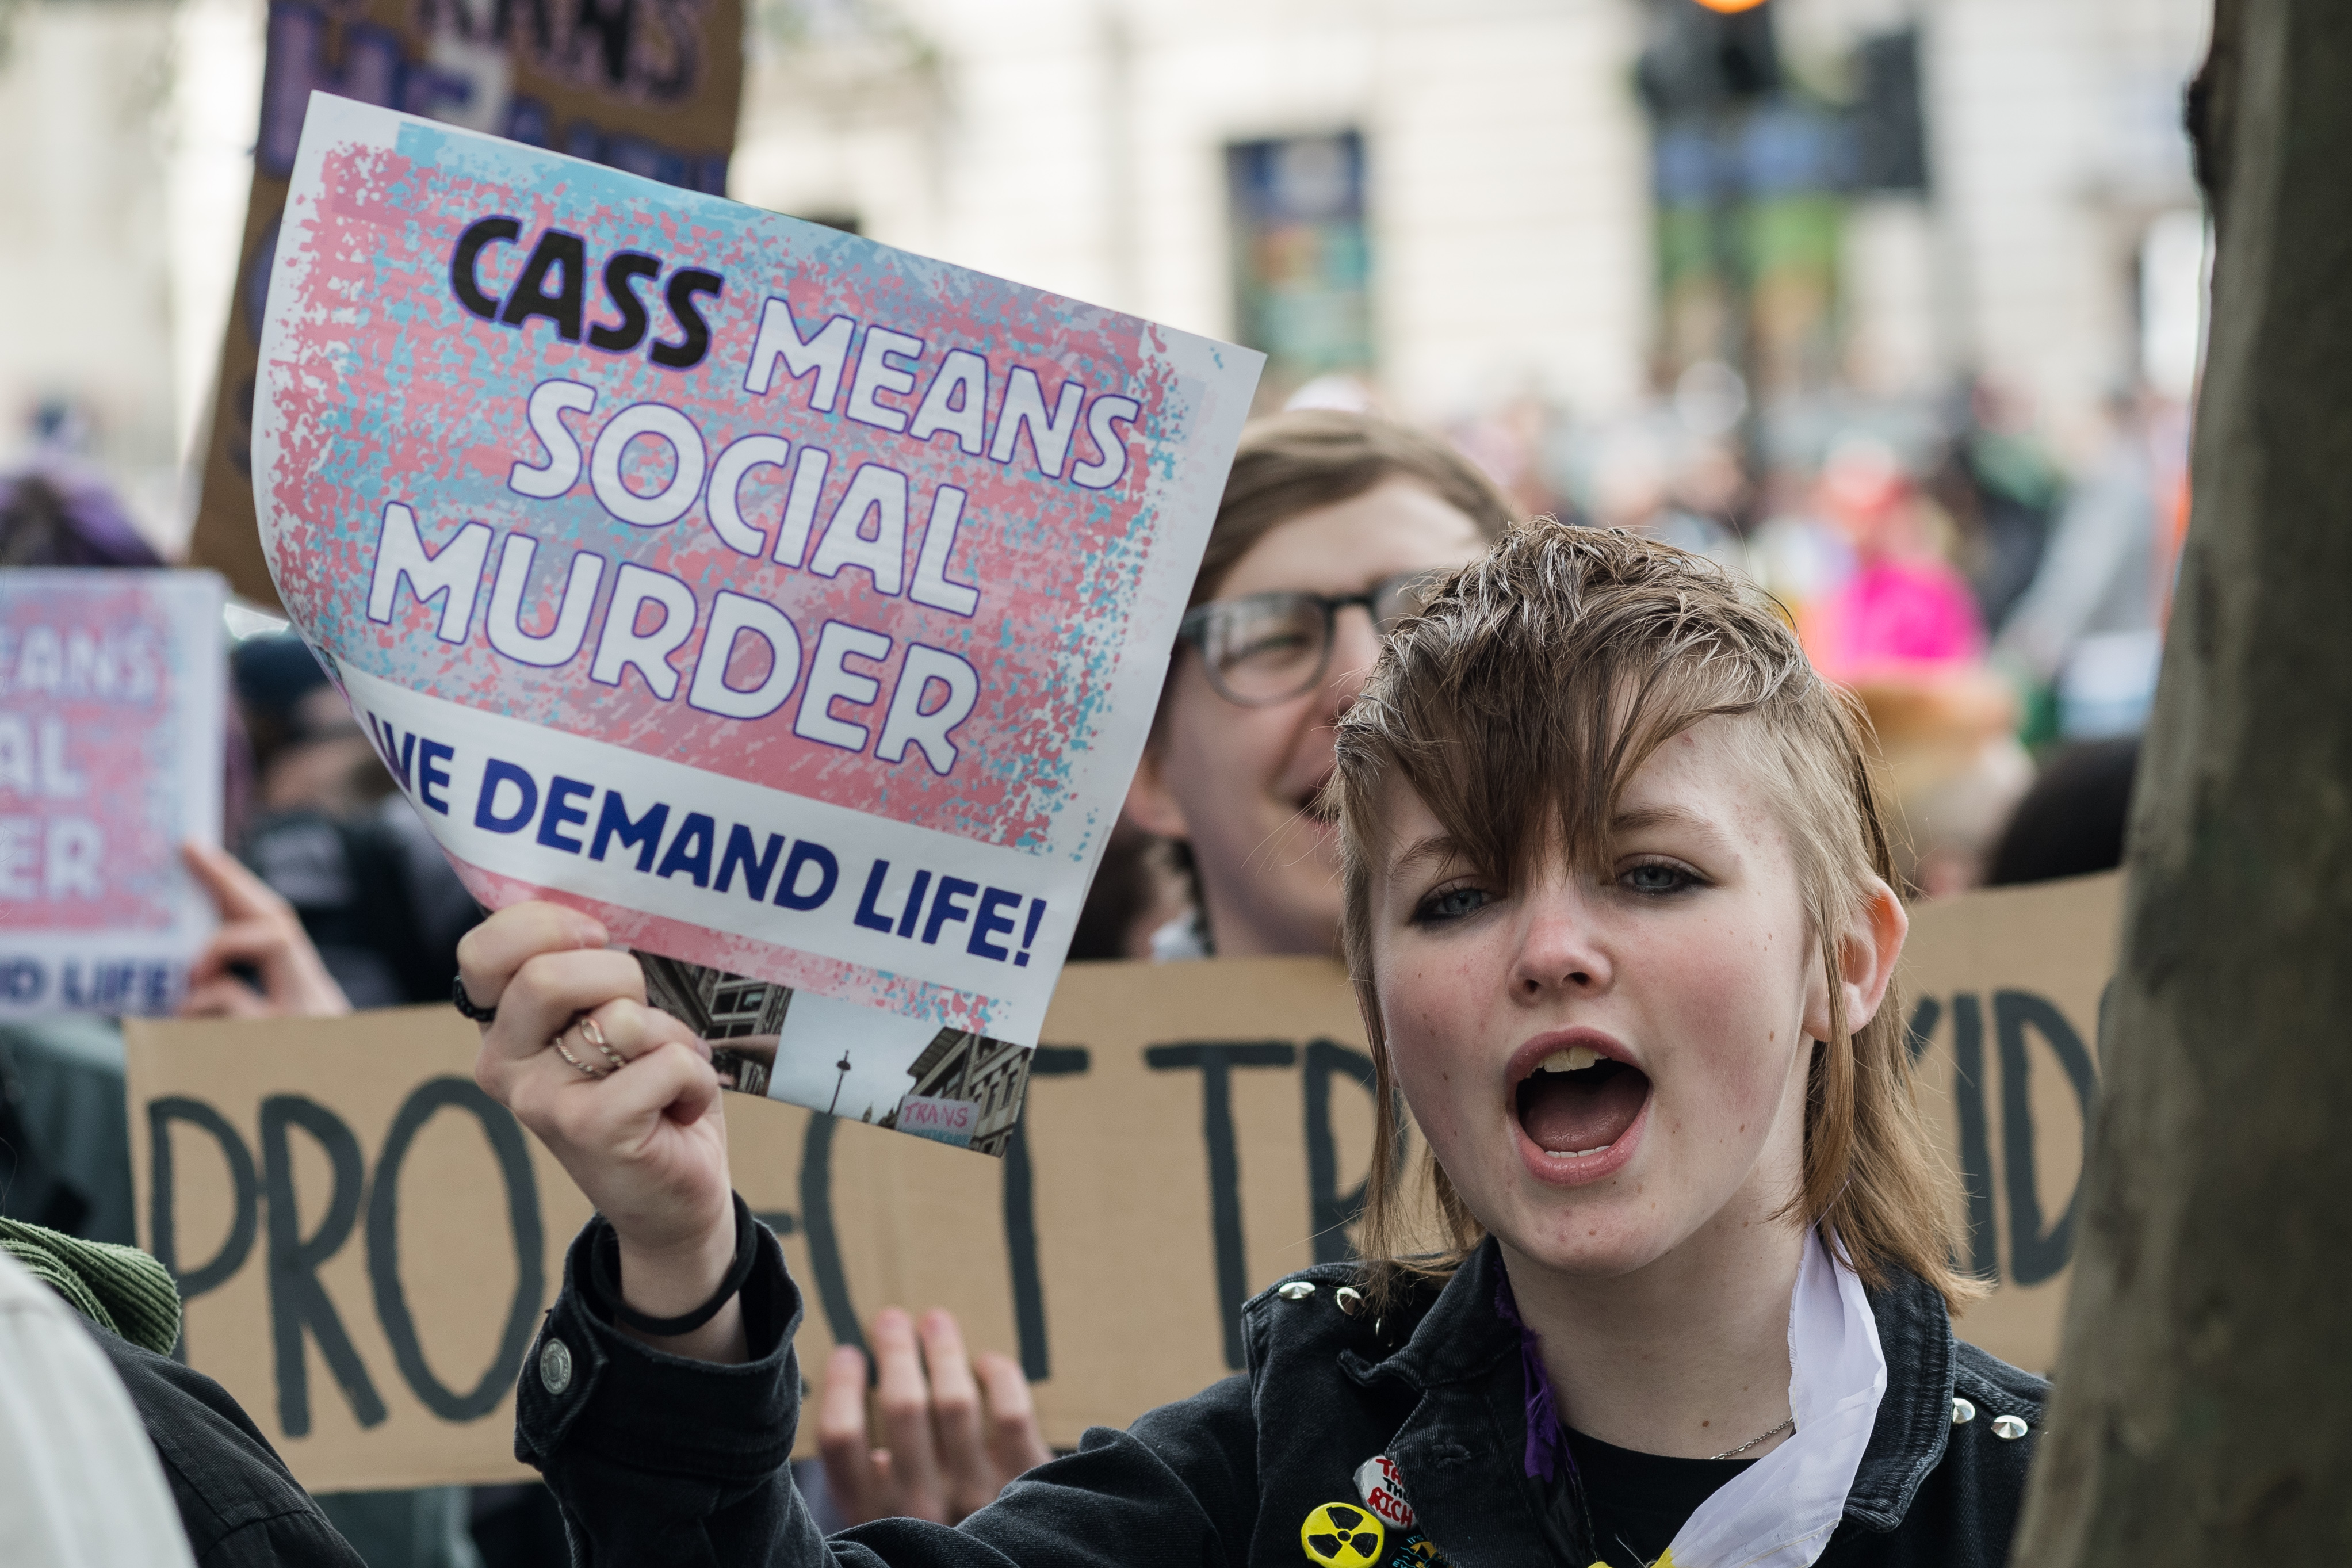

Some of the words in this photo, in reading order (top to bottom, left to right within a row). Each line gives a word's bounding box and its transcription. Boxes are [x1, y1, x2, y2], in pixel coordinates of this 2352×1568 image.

[448, 215, 725, 372] CASS
[743, 296, 1141, 490] MEANS
[507, 378, 981, 619] SOCIAL
[366, 500, 981, 777] MURDER
[473, 757, 840, 912] DEMAND
[853, 859, 1049, 968] LIFE!
[62, 955, 181, 1017] LIFE
[904, 1101, 969, 1129] TRANS
[1375, 1458, 1403, 1486] TA
[1382, 1476, 1410, 1504] TH
[1367, 1486, 1414, 1529] RICH
[1406, 1535, 1424, 1545] IT'S
